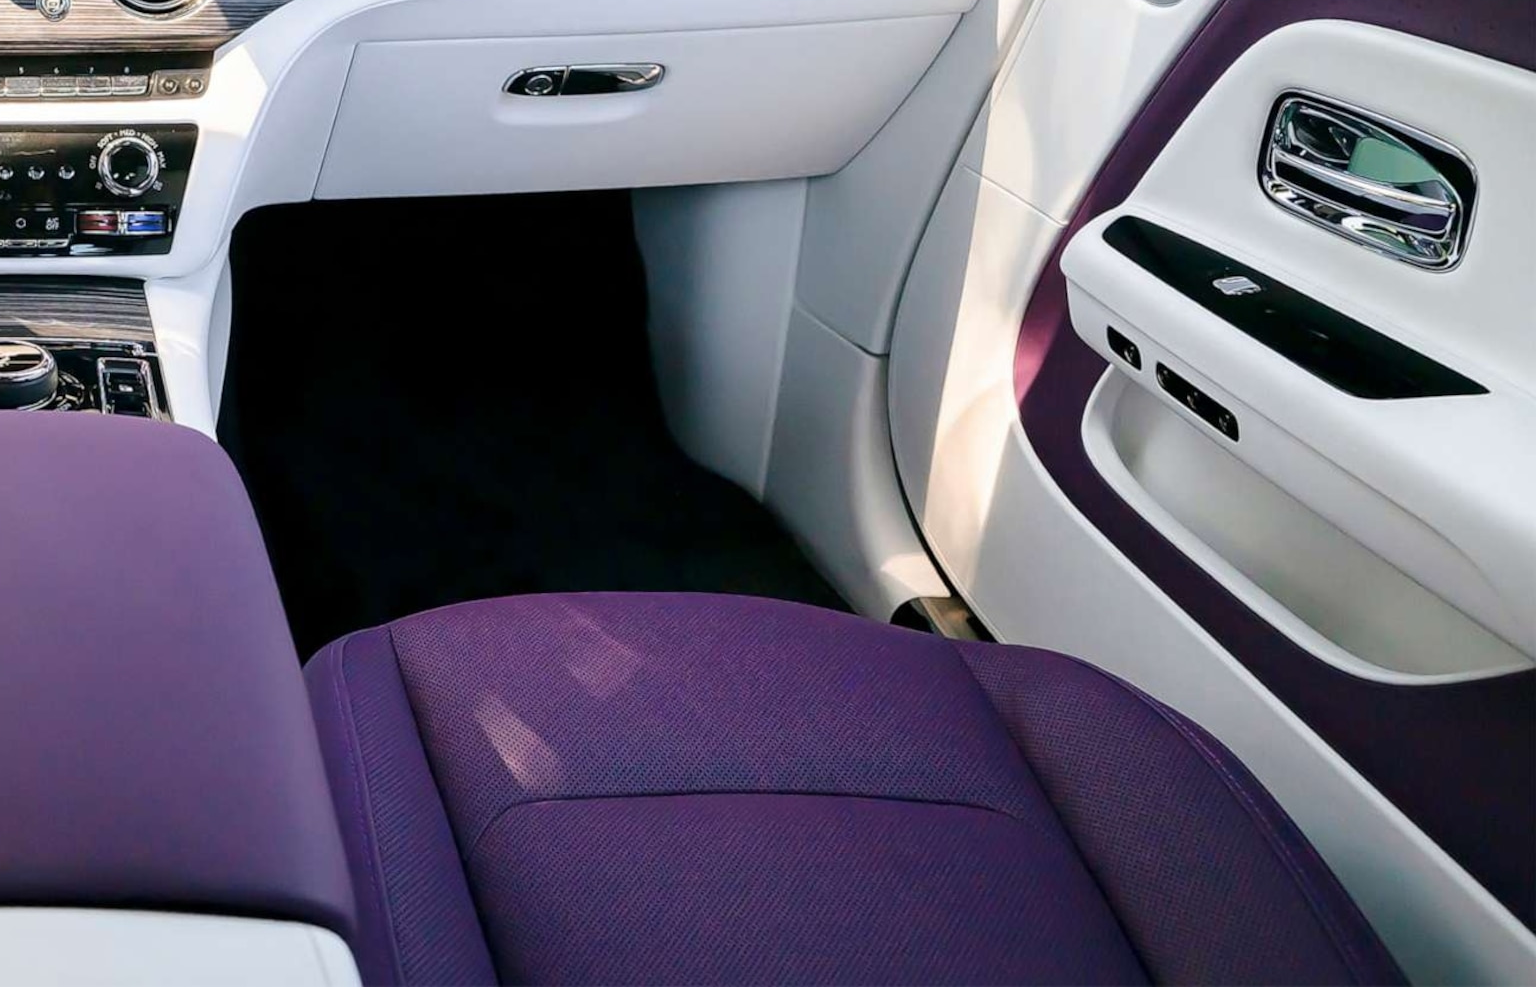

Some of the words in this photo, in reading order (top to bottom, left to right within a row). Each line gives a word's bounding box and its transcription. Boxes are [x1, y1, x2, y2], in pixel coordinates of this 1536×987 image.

[89, 154, 98, 169] OFF
[97, 132, 114, 149] SOFT
[119, 128, 136, 137] MED
[141, 132, 159, 149] HIGH
[157, 151, 167, 169] MAX
